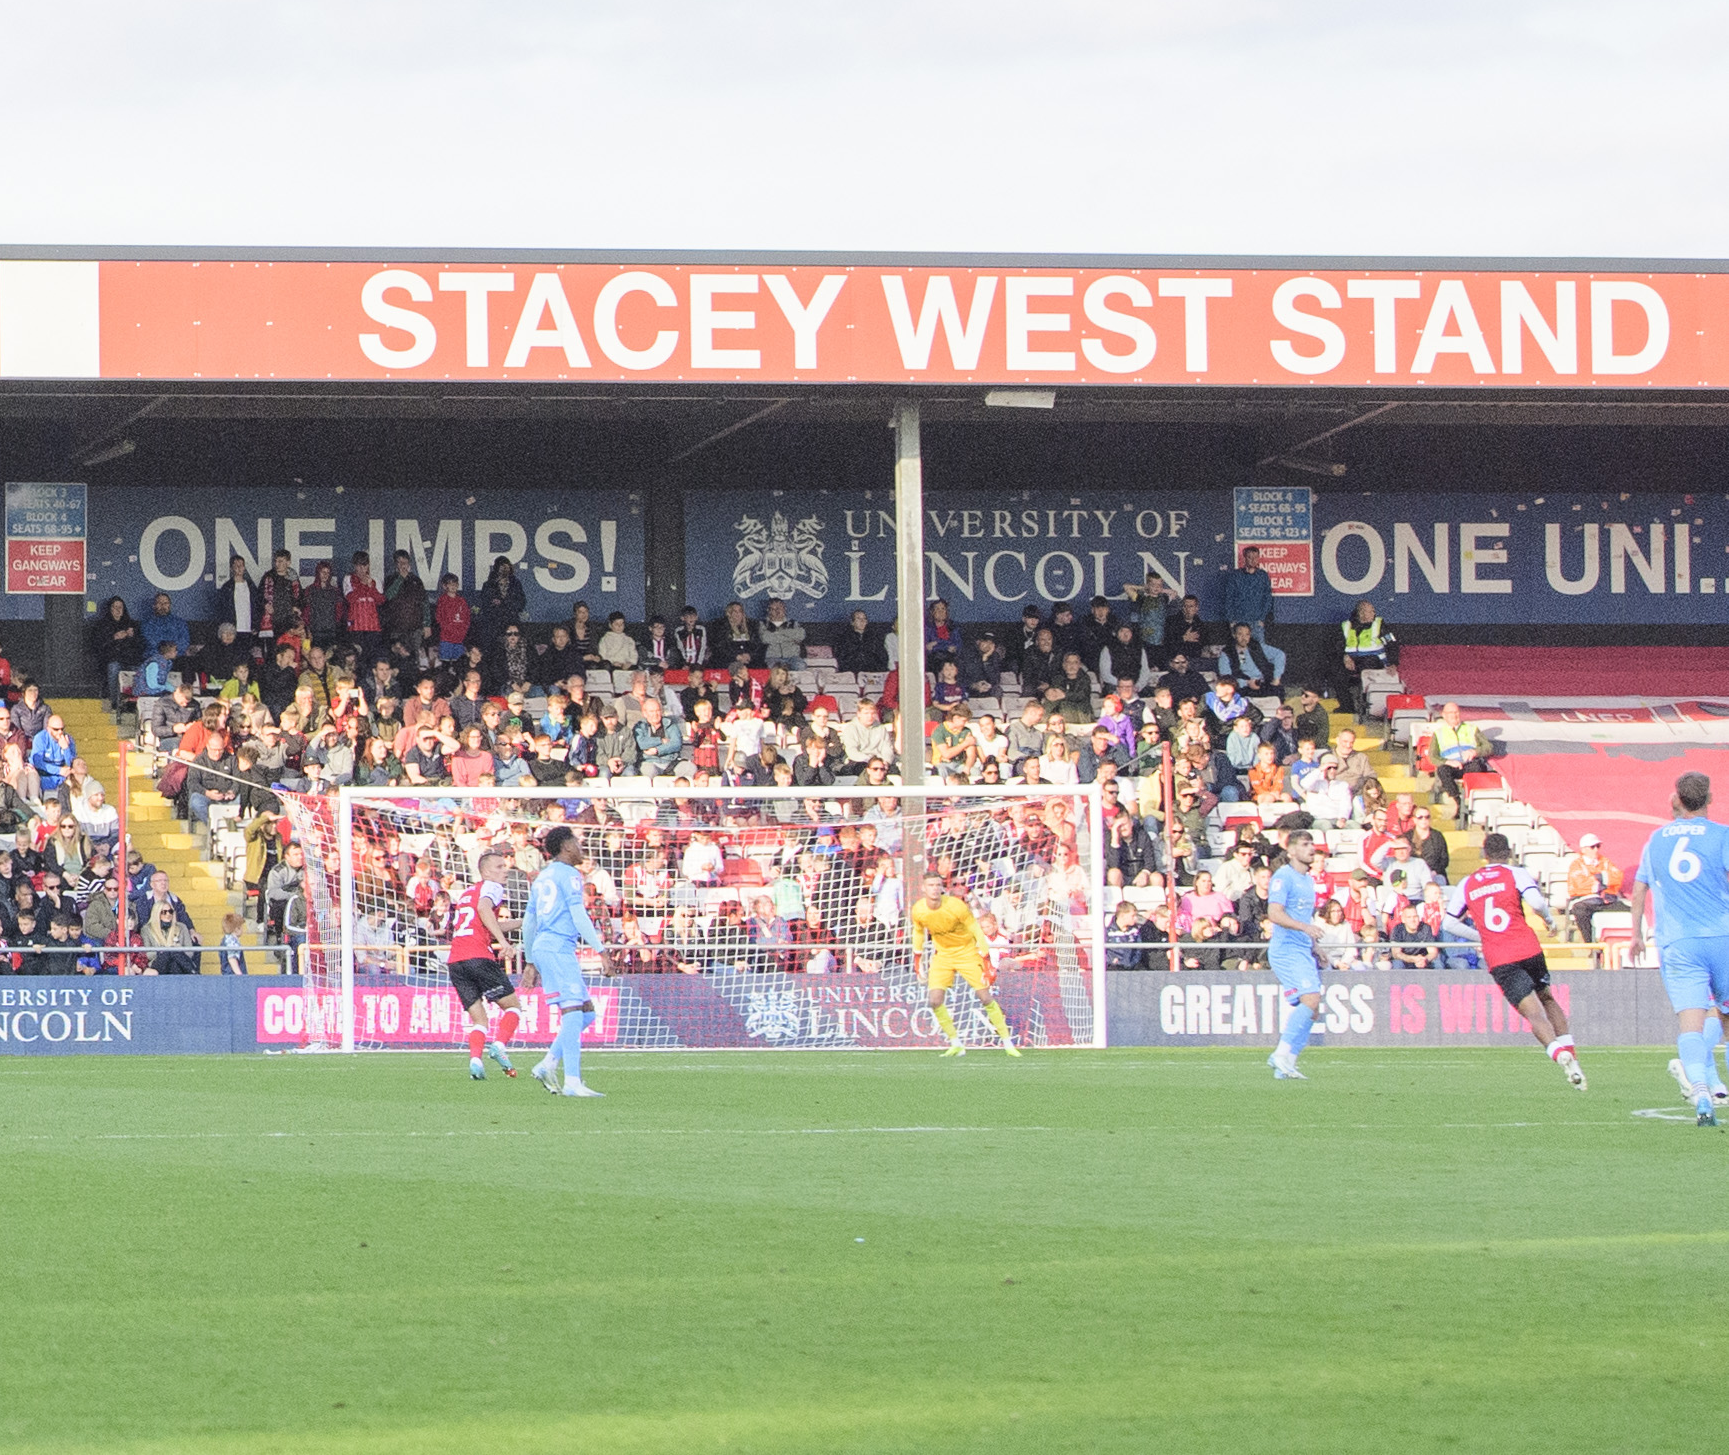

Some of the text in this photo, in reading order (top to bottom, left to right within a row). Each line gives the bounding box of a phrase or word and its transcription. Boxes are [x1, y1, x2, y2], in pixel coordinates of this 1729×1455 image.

[358, 270, 1670, 375] STACEY WEST STAND
[1252, 492, 1293, 502] BLOCK 4
[1248, 504, 1277, 513] SEATS
[26, 513, 67, 522] BLOCK 4
[1253, 516, 1293, 525] BLOCK 5
[12, 524, 42, 534] SEATS
[843, 510, 1190, 539] UNVERSITY OF
[1239, 528, 1267, 537] SEATS
[30, 545, 61, 556] KEEP
[139, 515, 617, 593] ONE IMPS!
[1259, 547, 1288, 558] KEEP
[1321, 521, 1513, 595] ONE
[12, 559, 81, 571] GANGWAYS
[27, 575, 66, 587] CLEAR
[844, 550, 1190, 601] LNCOLN
[1271, 577, 1293, 588] EAR
[1662, 824, 1706, 837] COOPER
[1669, 837, 1701, 882] 6
[1484, 896, 1510, 933] 6
[101, 988, 134, 1005] OF
[363, 994, 399, 1034] TO
[409, 994, 450, 1034] AN
[1390, 984, 1427, 1034] IS
